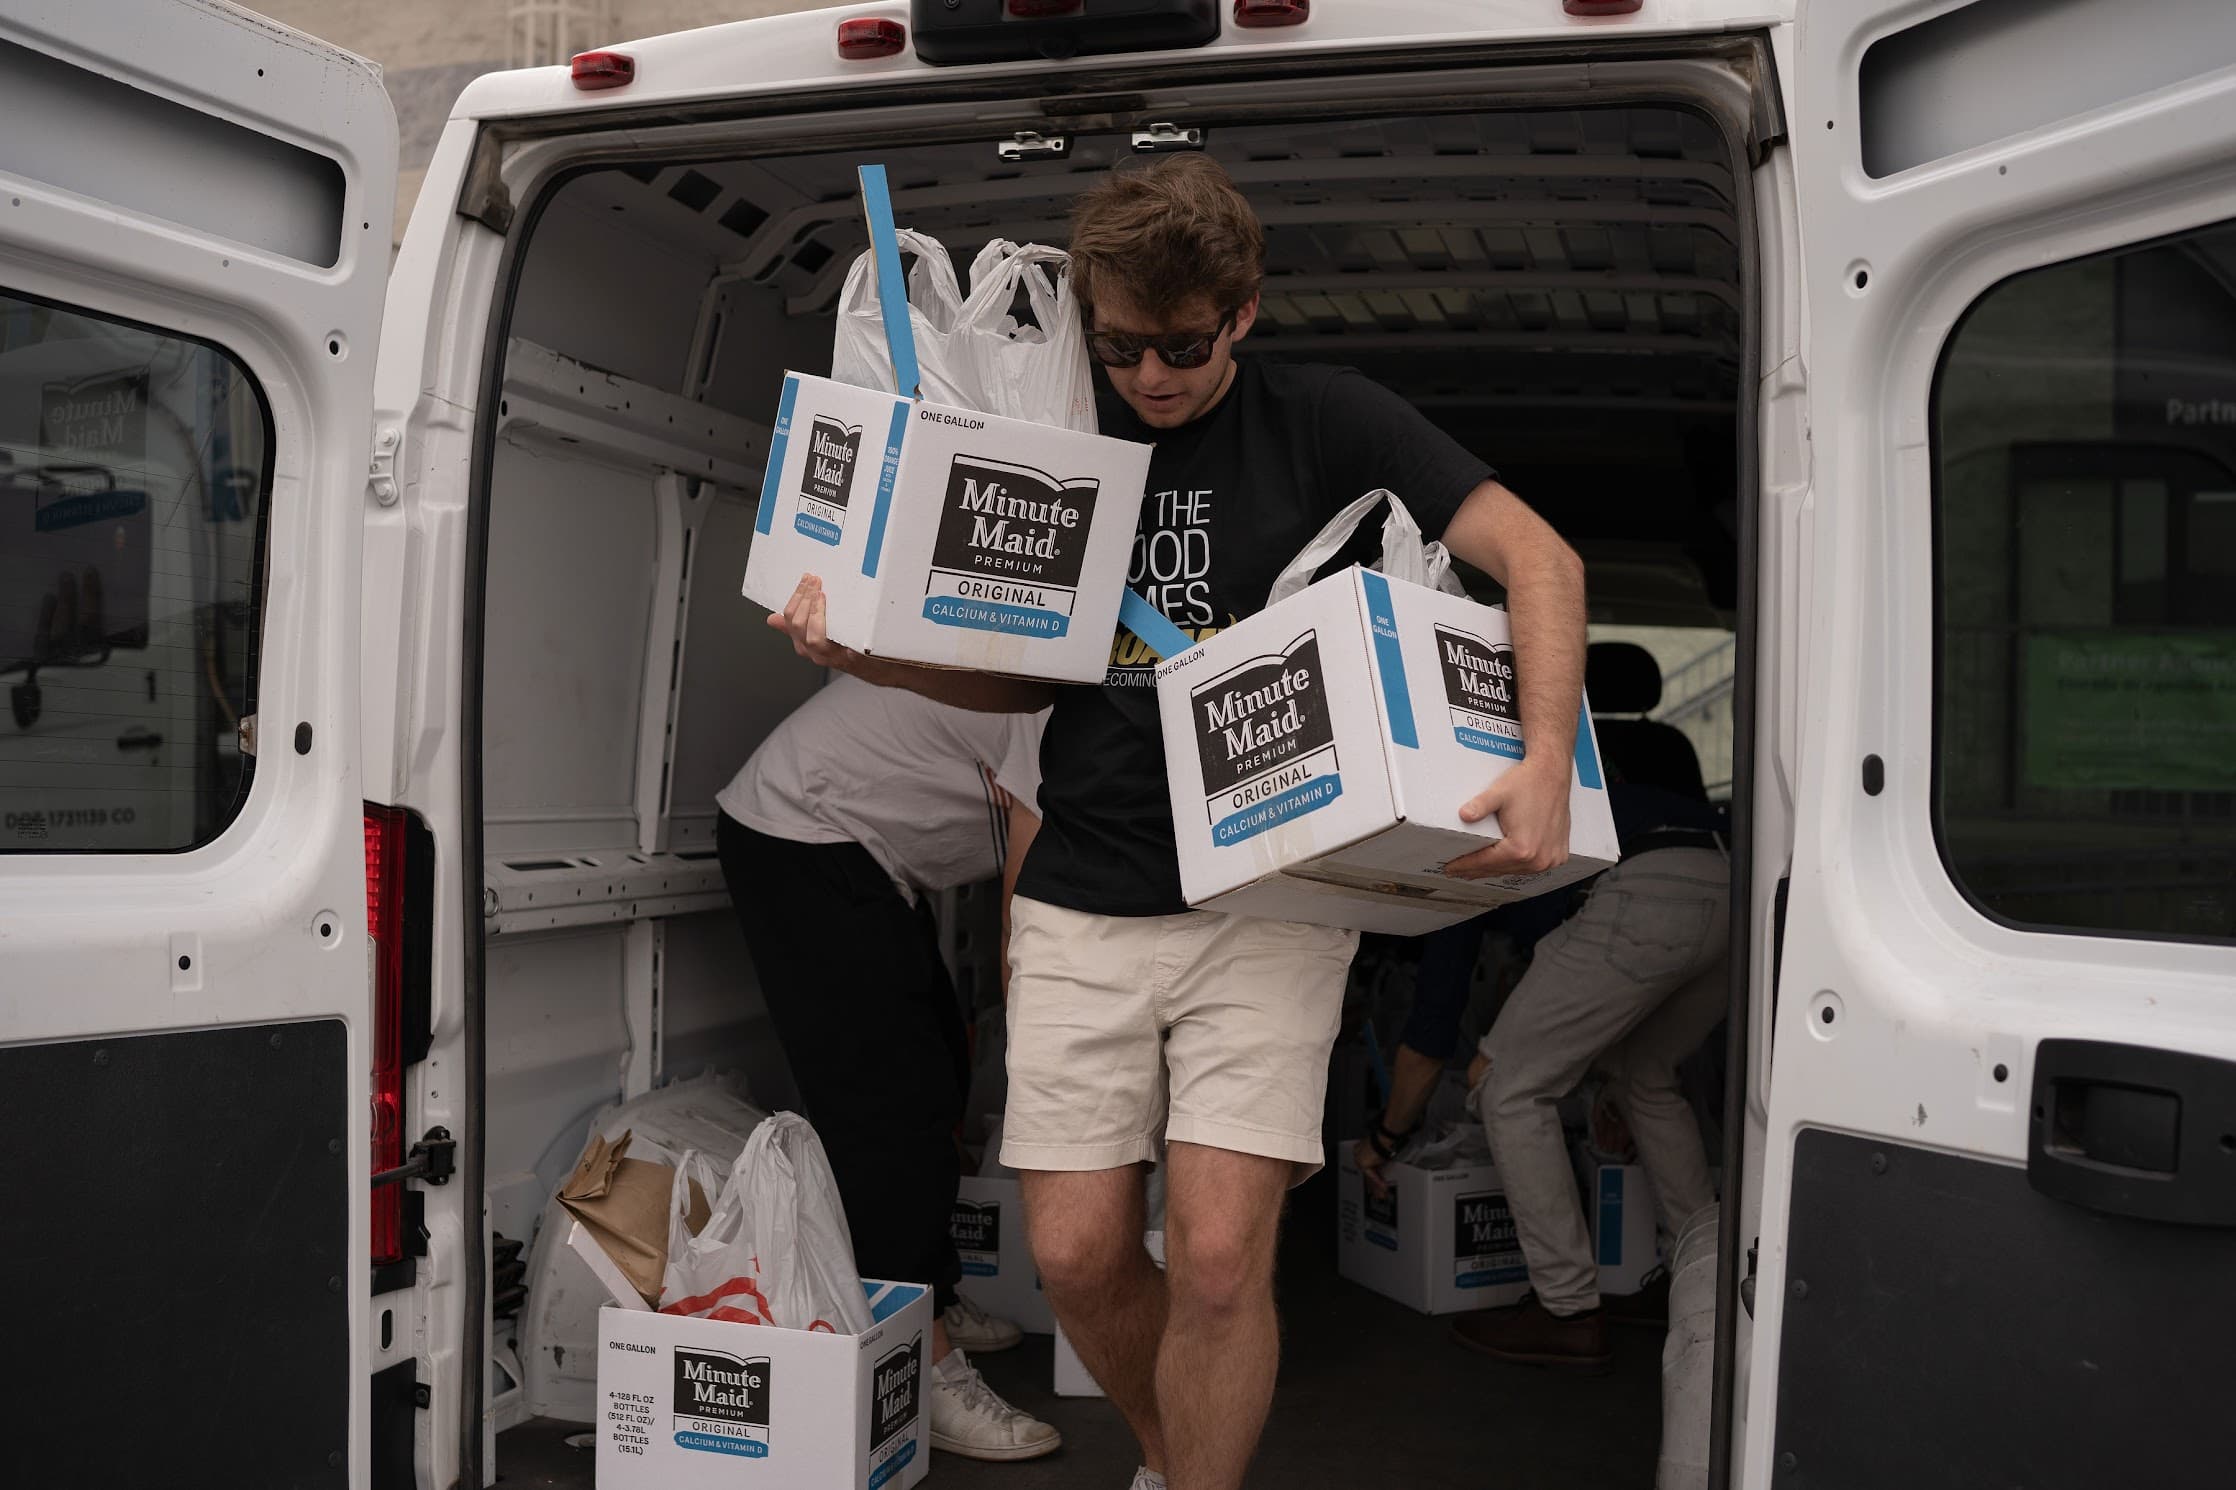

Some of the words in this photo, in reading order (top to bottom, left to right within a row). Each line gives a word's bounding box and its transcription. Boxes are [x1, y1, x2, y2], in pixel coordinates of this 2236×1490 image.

[921, 411, 942, 423] ONE
[944, 415, 984, 430] GALLON
[813, 430, 853, 463] Minute
[813, 456, 844, 487] Maid
[814, 484, 837, 498] PREMIUM
[959, 478, 1080, 528] Minute
[806, 503, 835, 522] ORIGINAL
[1154, 490, 1213, 527] THE
[968, 515, 1055, 559] Maid
[975, 555, 1043, 574] PREMIUM
[958, 580, 1046, 607] ORIGINAL
[932, 603, 987, 621] CALCIUM
[1000, 613, 1049, 630] VITAMIN
[1052, 620, 1060, 631] D
[1376, 615, 1390, 627] ONE
[1372, 624, 1397, 640] GALLON
[1157, 664, 1173, 680] ONE
[1173, 648, 1206, 672] GALLON
[1444, 639, 1513, 681] Minute
[1457, 667, 1510, 703] Maid
[1204, 668, 1310, 734] Minute
[1468, 697, 1507, 713] PREMIUM
[1222, 699, 1303, 761] Maid
[1459, 732, 1490, 747] CALCIUM
[1467, 716, 1518, 738] ORIGINAL
[1236, 739, 1297, 775] PREMIUM
[1233, 764, 1313, 809] ORIGINAL
[1219, 811, 1268, 839] CALCIUM
[1276, 787, 1323, 816] VITAMIN
[1325, 783, 1333, 795] D
[609, 1341, 626, 1351] ONE
[626, 1343, 656, 1355] GALLON
[682, 1359, 762, 1389] Minute
[877, 1358, 918, 1401] Minute
[610, 1391, 631, 1401] 4-128
[632, 1394, 641, 1403] FL
[643, 1395, 654, 1404] OZ
[614, 1402, 650, 1414] BOTTLES
[693, 1381, 751, 1409] Maid
[881, 1381, 911, 1424] Maid
[608, 1411, 624, 1421] (512
[626, 1414, 635, 1422] FL
[699, 1405, 744, 1418] PREMIUM
[613, 1433, 649, 1445] BOTTLES
[692, 1421, 751, 1438] ORIGINAL
[679, 1436, 715, 1448] CALCIUM
[722, 1441, 755, 1453] VITAMIN
[756, 1446, 762, 1454] D
